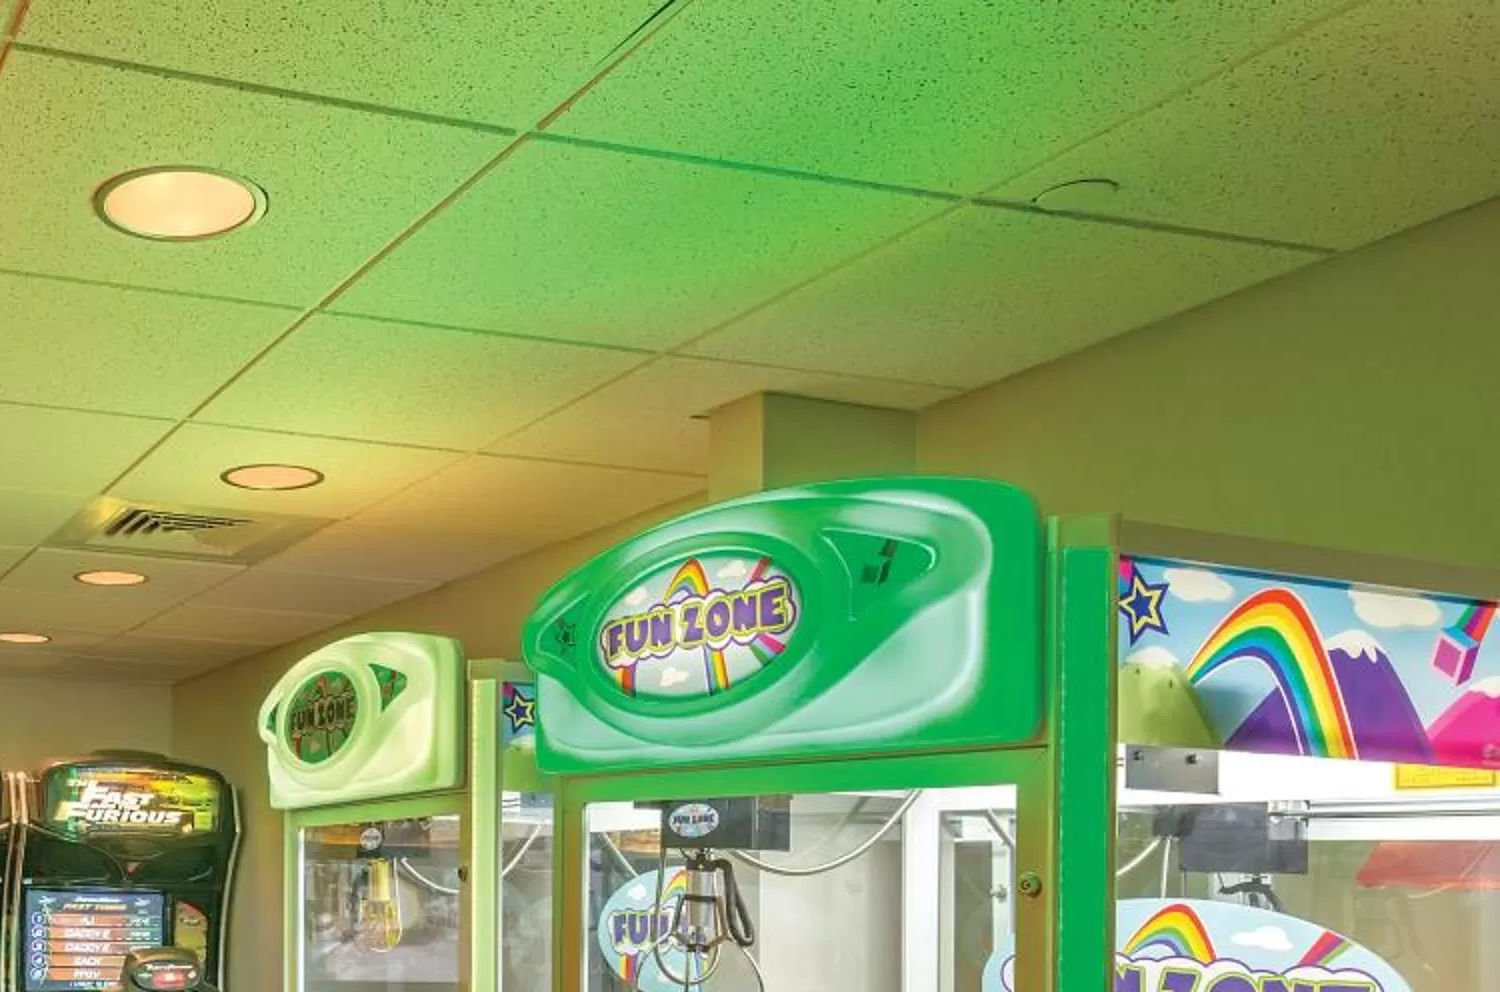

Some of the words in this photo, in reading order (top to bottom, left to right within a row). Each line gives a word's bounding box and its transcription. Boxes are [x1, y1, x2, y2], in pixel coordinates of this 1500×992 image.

[607, 609, 675, 658] FUN
[680, 579, 789, 645] ZONE
[80, 784, 156, 807] FAST
[53, 801, 184, 824] FURIOUS
